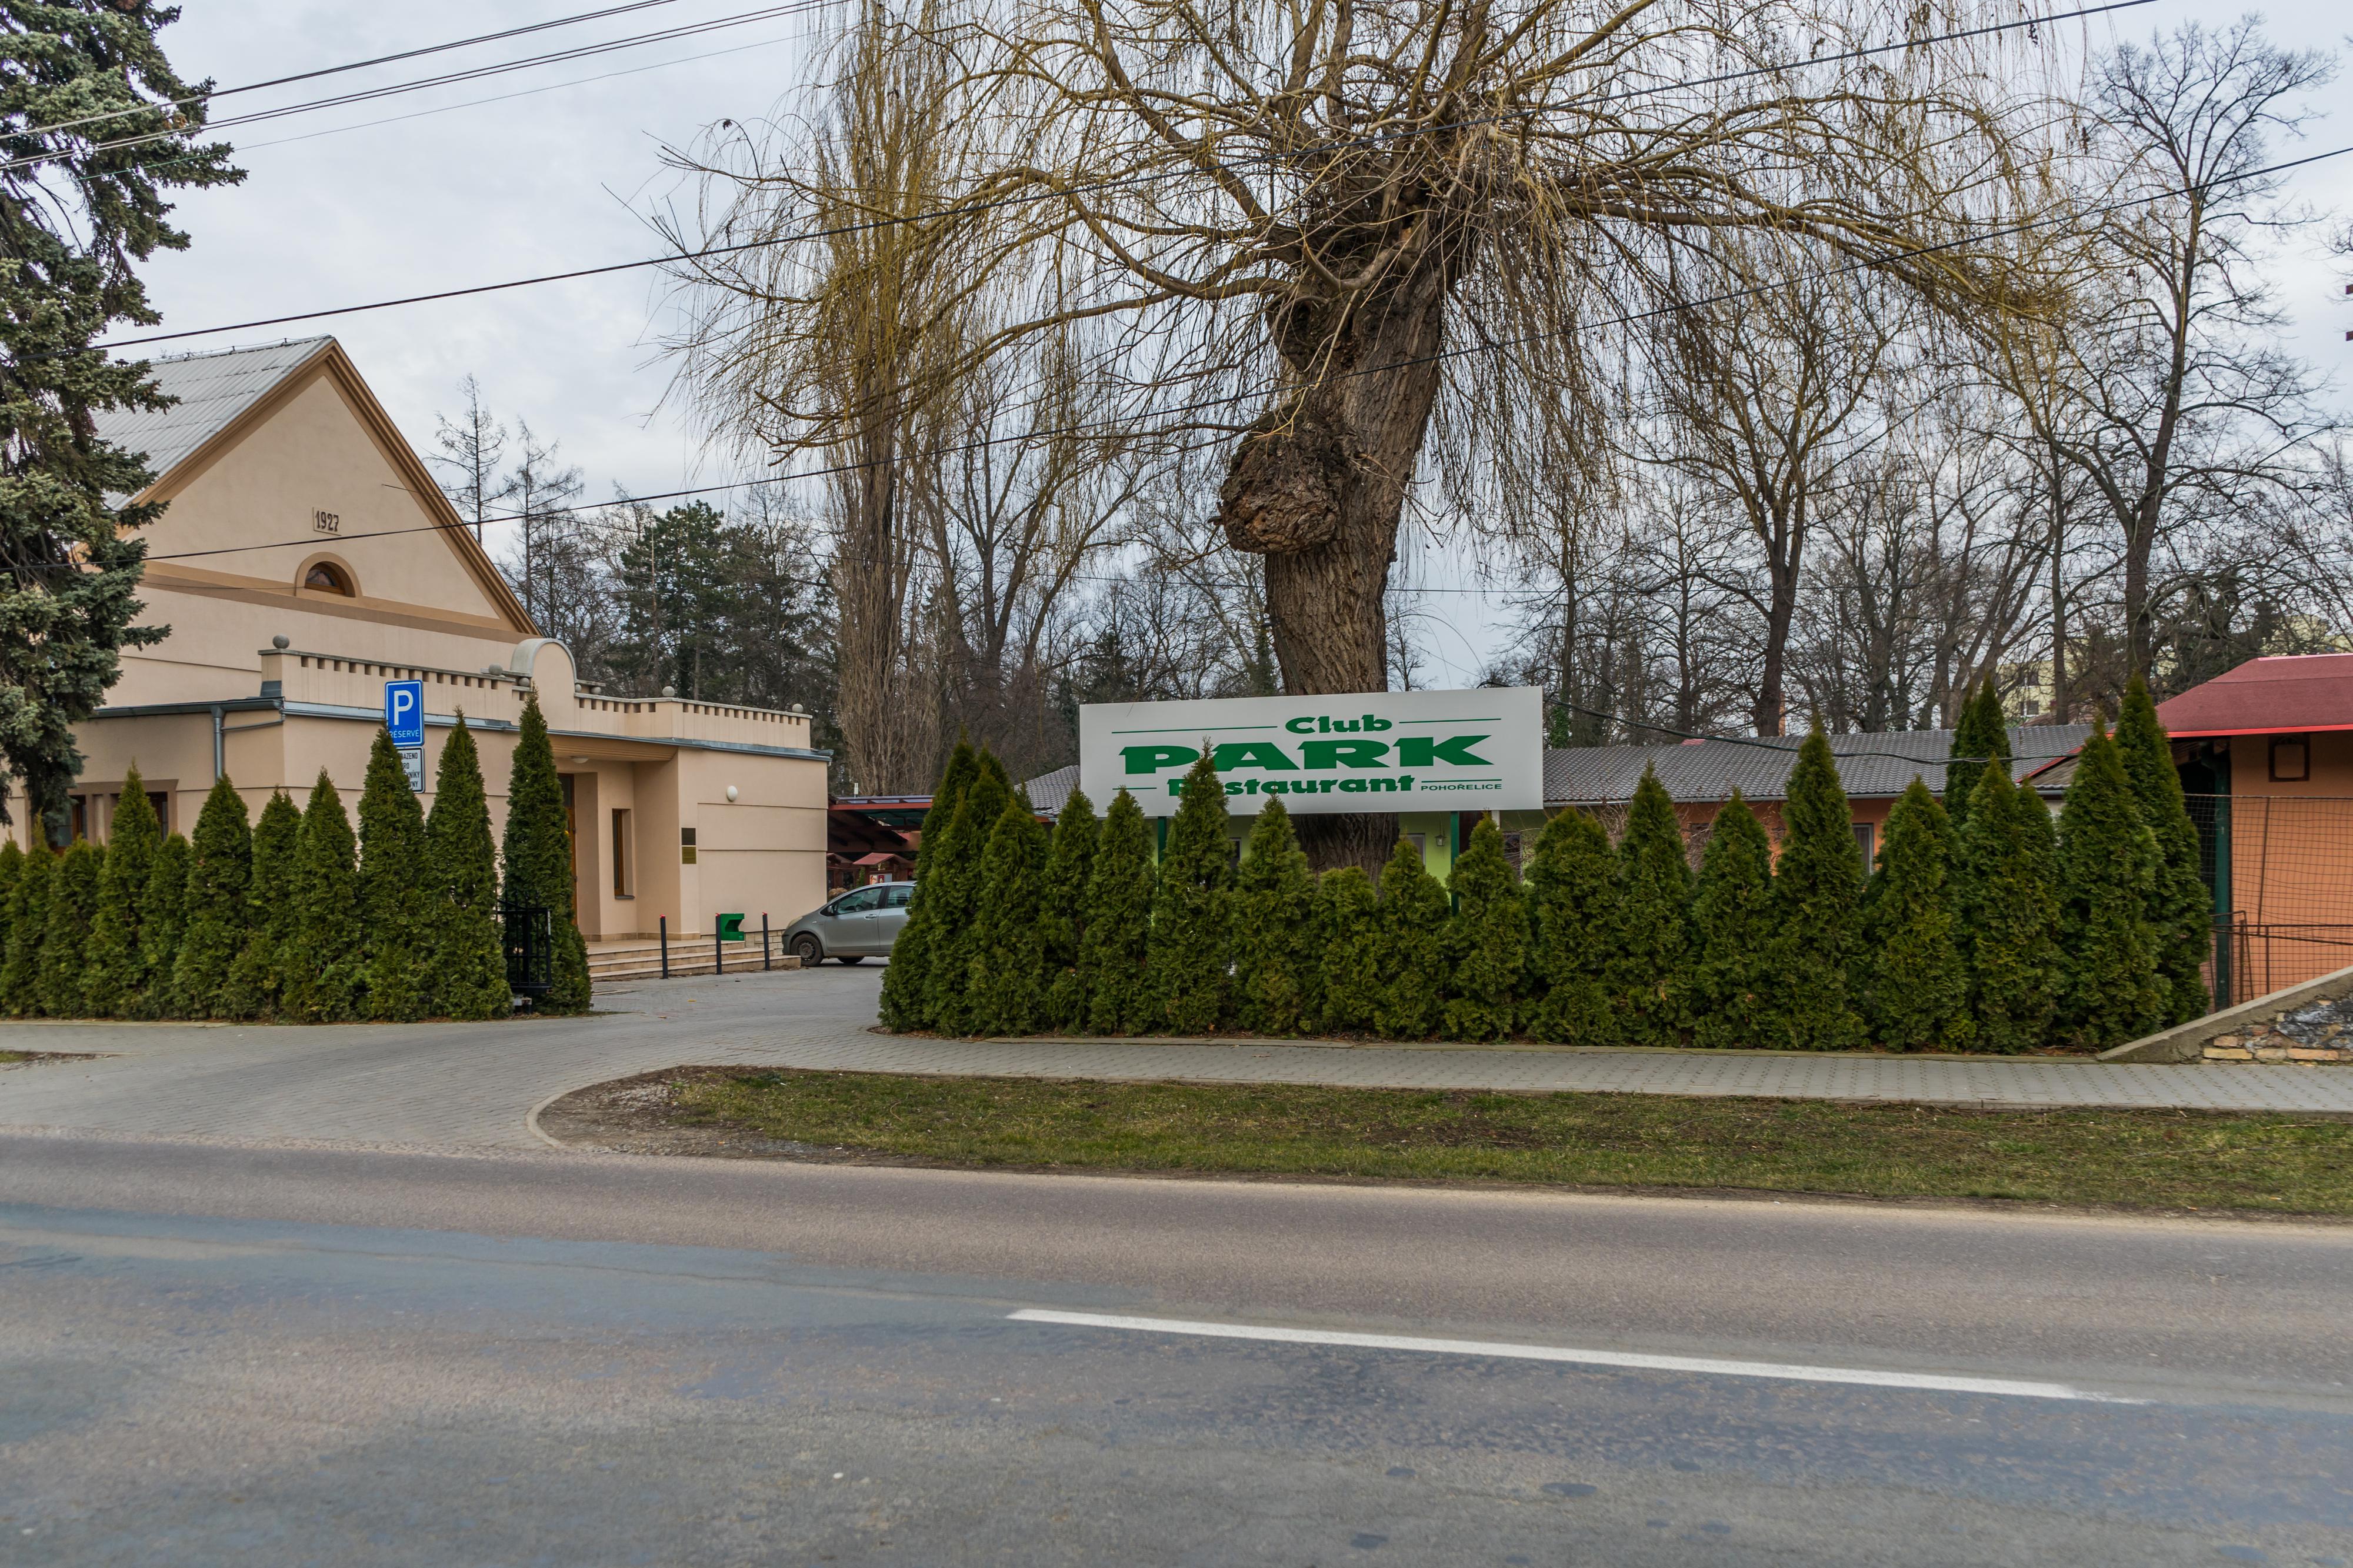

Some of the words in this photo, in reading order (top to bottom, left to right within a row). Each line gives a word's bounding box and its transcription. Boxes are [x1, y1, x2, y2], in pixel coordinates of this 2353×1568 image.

[315, 510, 339, 532] 1927
[394, 690, 414, 725] P
[1285, 714, 1393, 734] Club
[1118, 735, 1495, 775] PARK
[1167, 775, 1415, 796] Rstaurant
